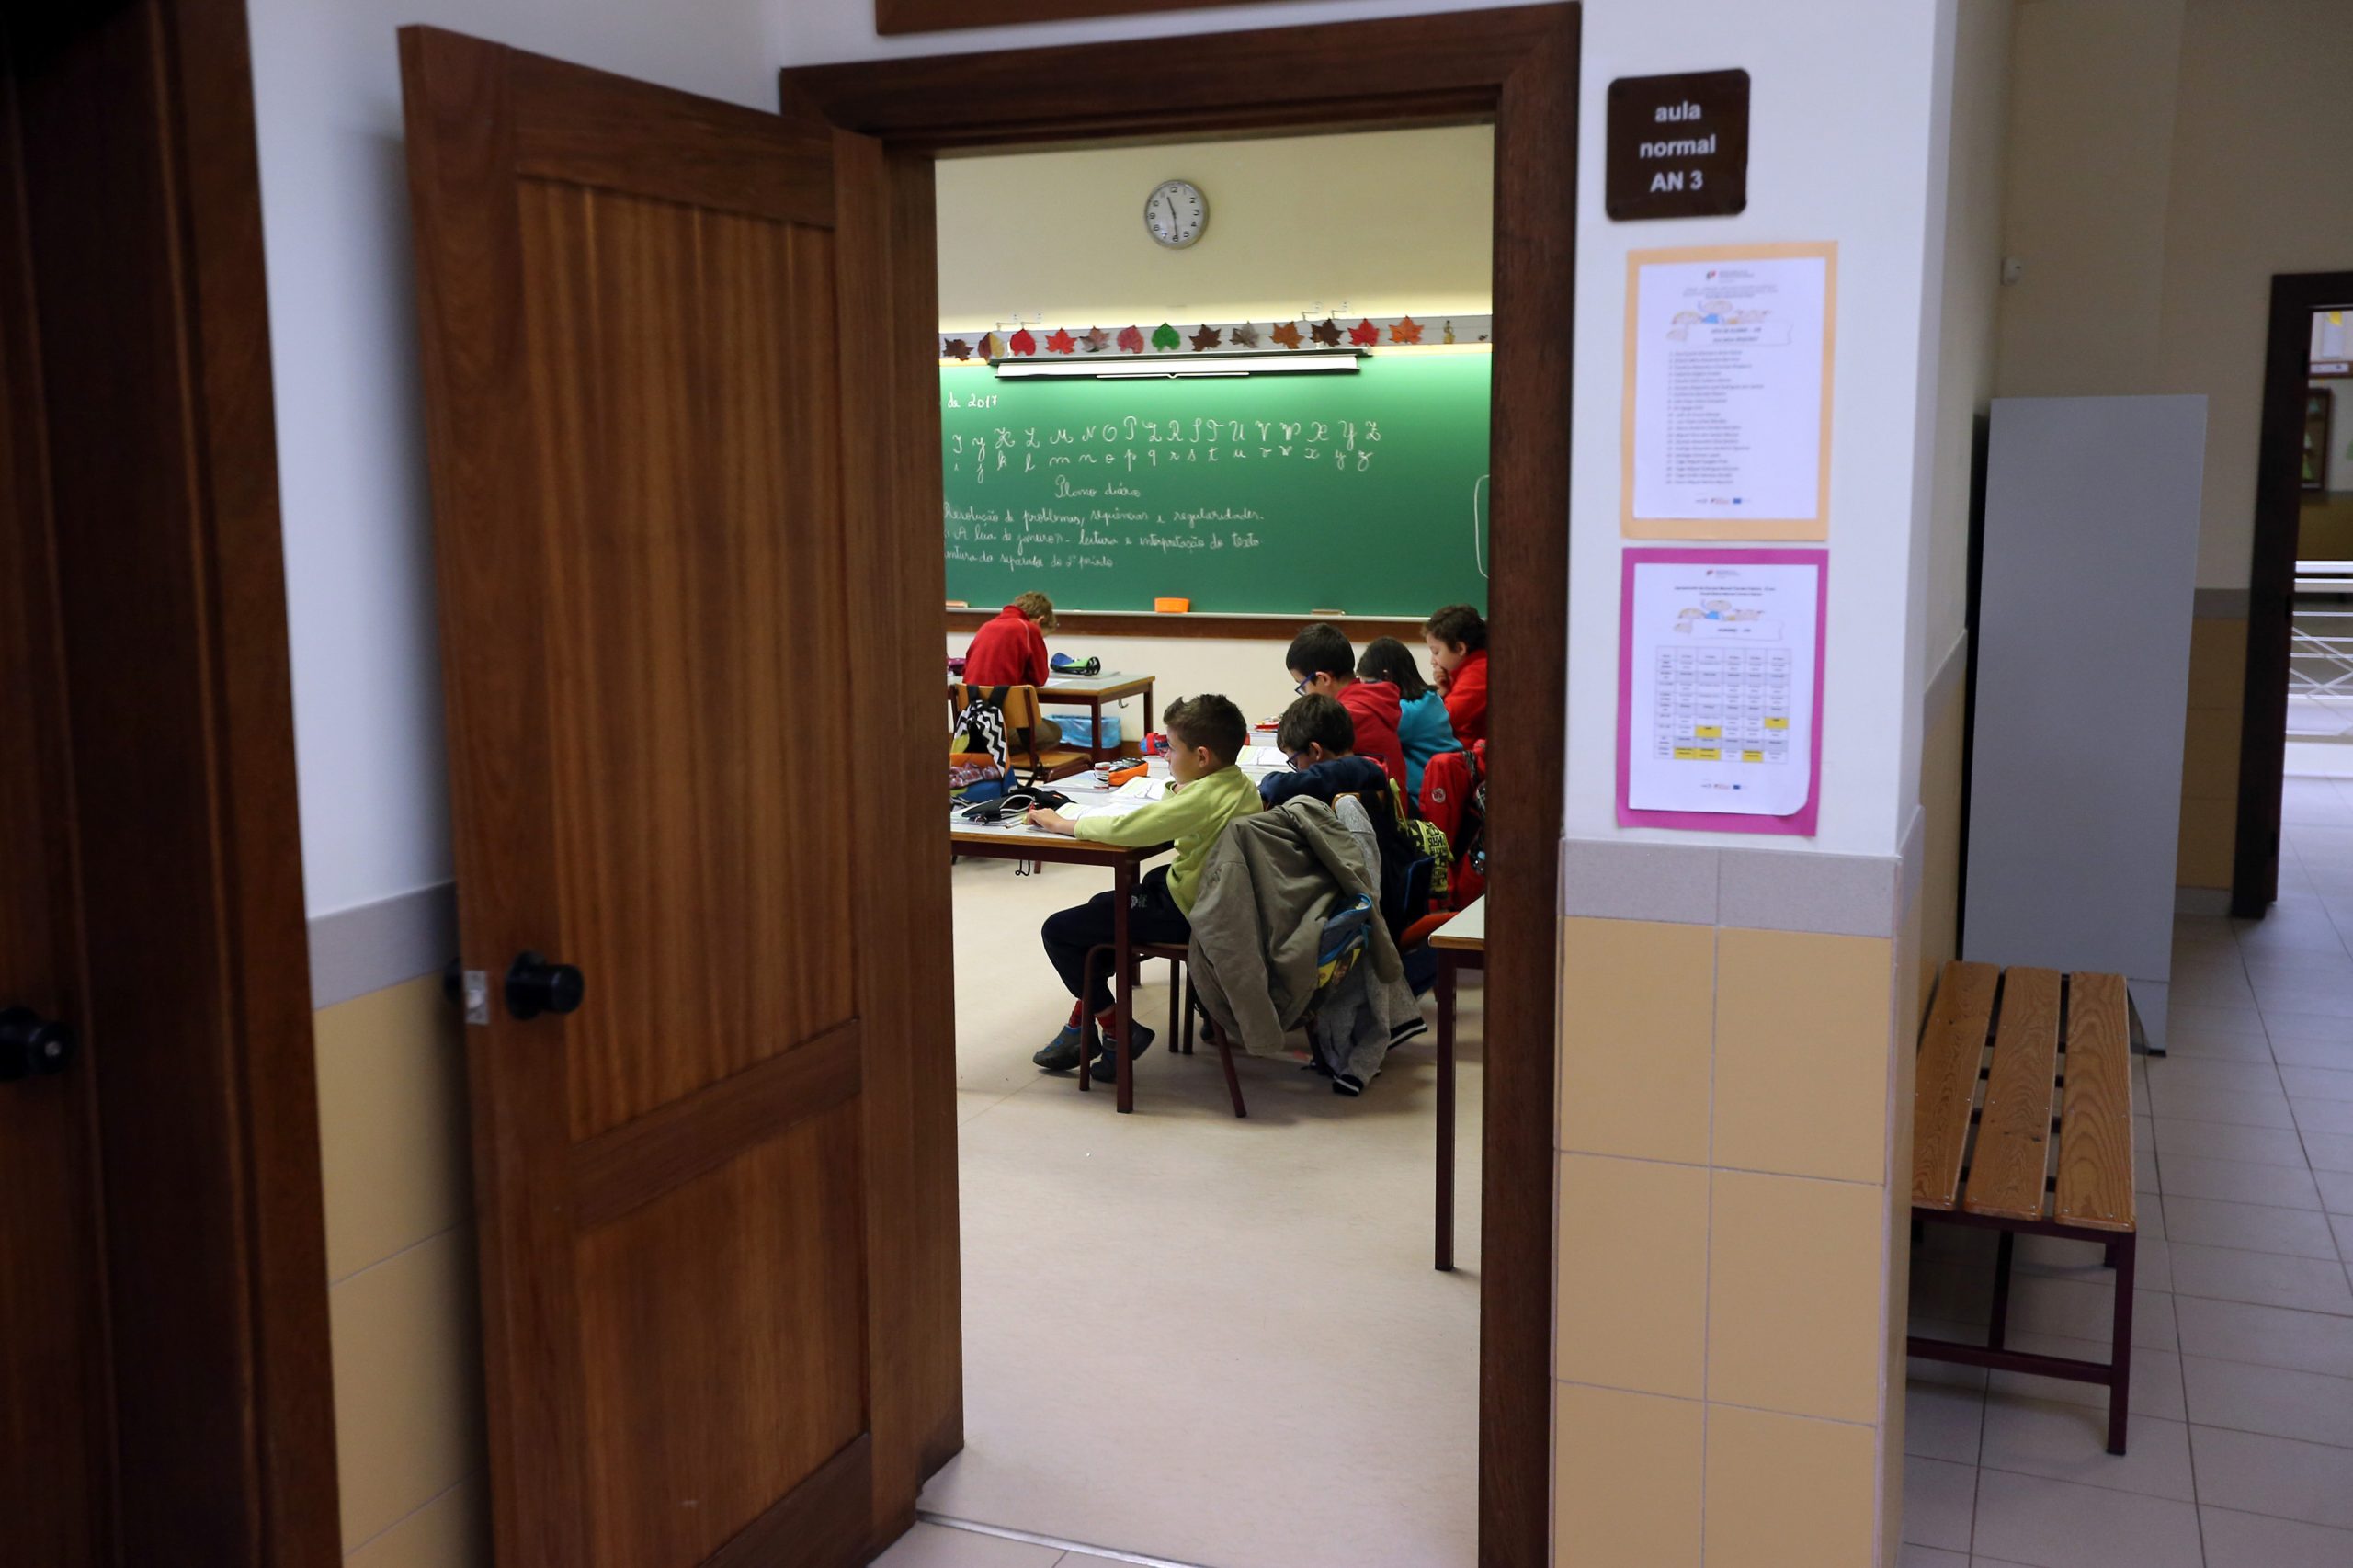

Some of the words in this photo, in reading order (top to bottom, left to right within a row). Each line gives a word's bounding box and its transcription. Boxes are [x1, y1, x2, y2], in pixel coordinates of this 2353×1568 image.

[1654, 100, 1701, 122] aula
[1639, 133, 1717, 159] normal
[1649, 171, 1684, 193] AN
[1690, 170, 1703, 190] 3
[968, 393, 997, 408] 2017
[1054, 474, 1097, 498] Plano
